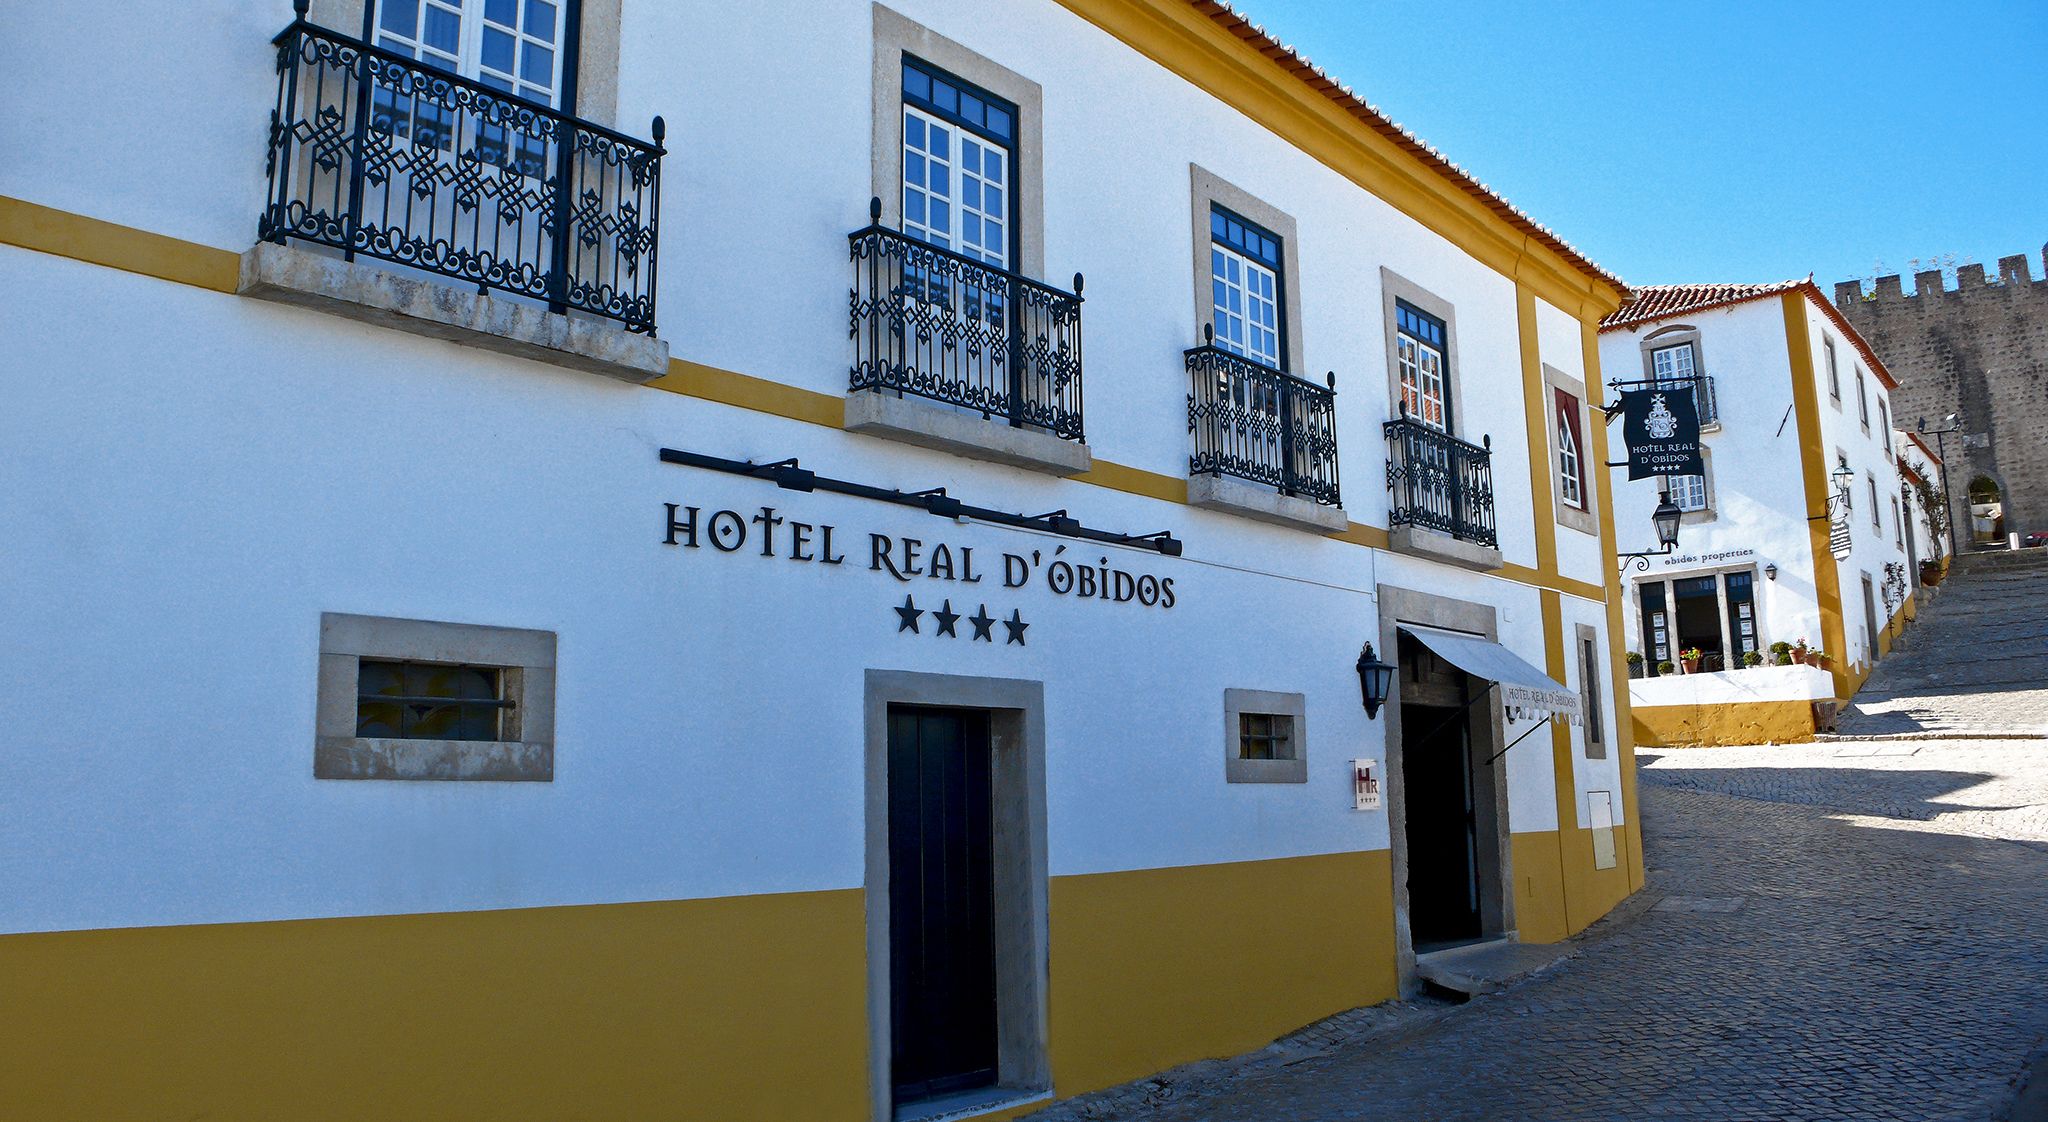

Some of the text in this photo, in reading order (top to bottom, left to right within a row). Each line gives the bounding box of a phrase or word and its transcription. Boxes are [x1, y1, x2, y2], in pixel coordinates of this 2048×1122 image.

[1632, 442, 1696, 453] HOTEL REAL
[662, 502, 1176, 609] HOTEL REAL D'ÓBIDOS
[1701, 548, 1754, 563] properties
[1508, 687, 1530, 700] HOTEL
